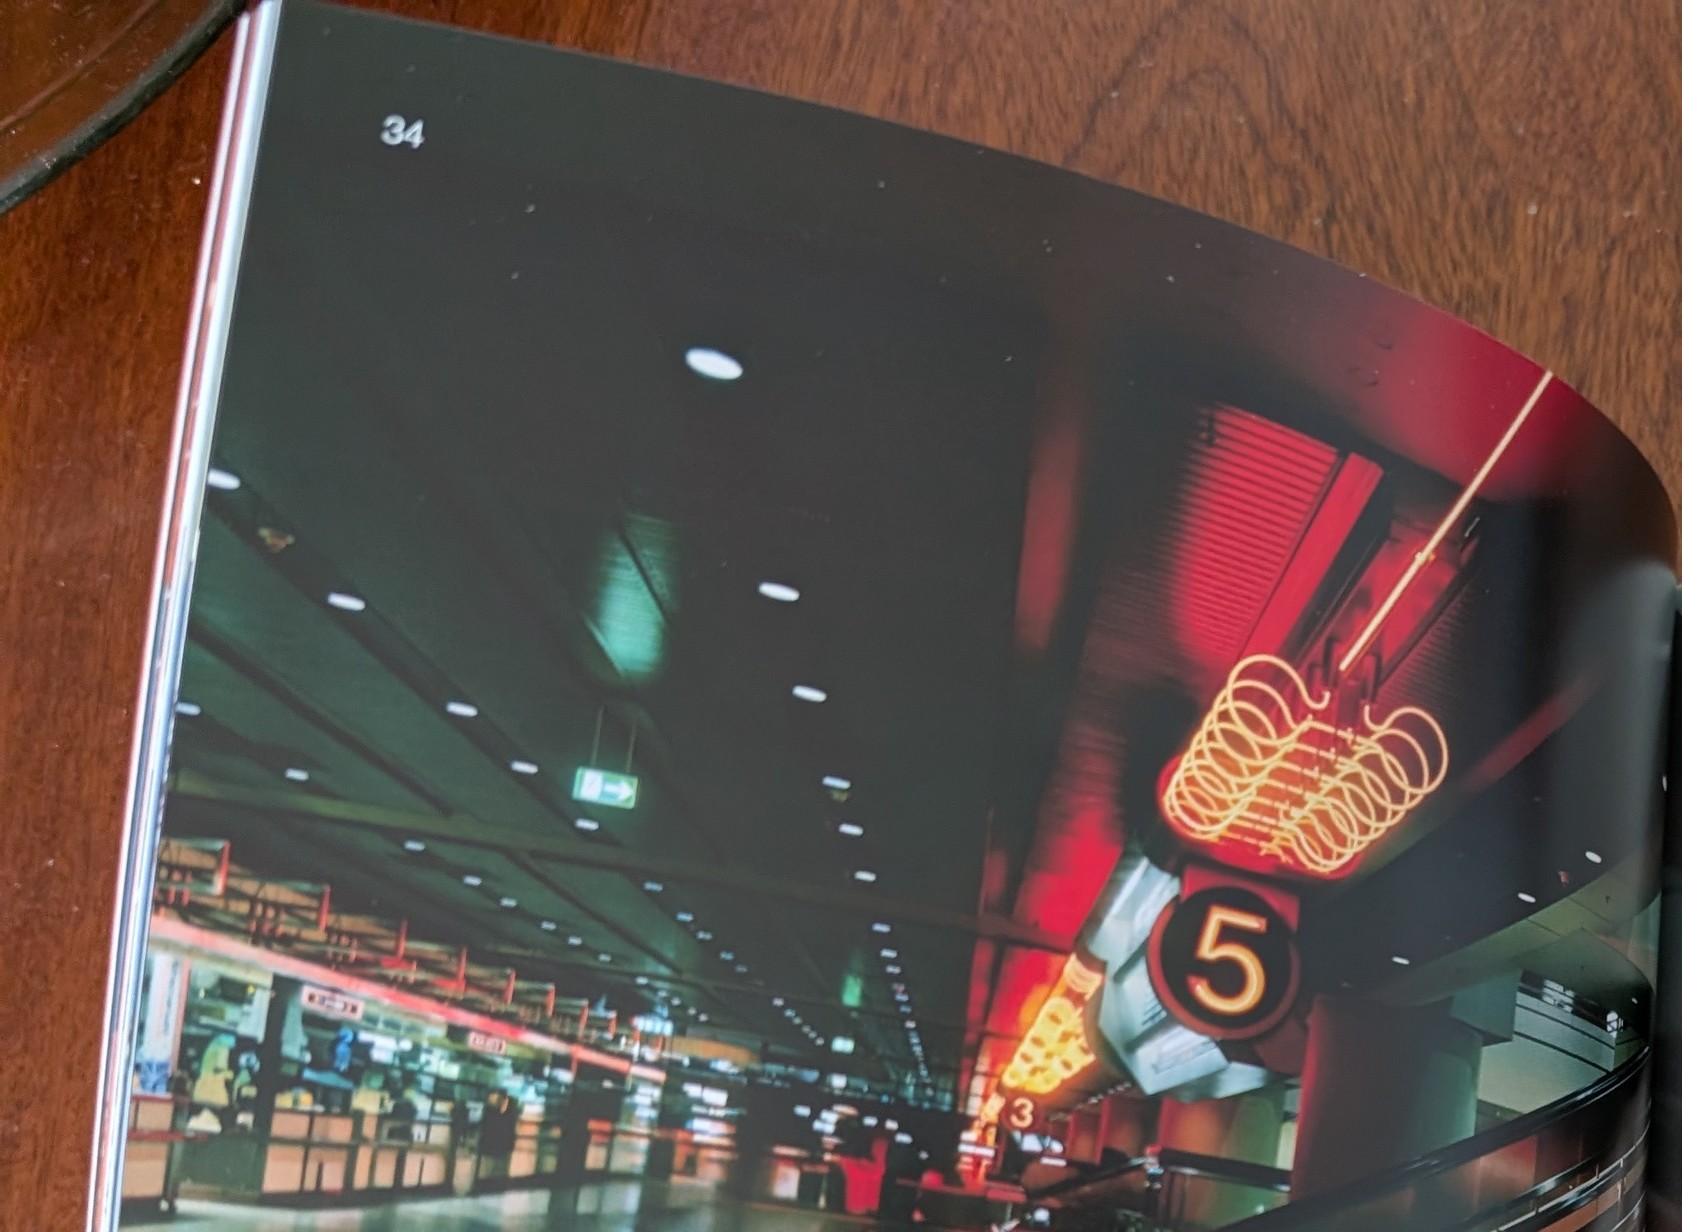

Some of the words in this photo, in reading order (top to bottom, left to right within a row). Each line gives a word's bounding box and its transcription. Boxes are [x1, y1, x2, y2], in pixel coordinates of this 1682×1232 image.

[381, 114, 425, 149] 34
[1187, 905, 1267, 1016] 5
[1010, 1098, 1034, 1127] 3
